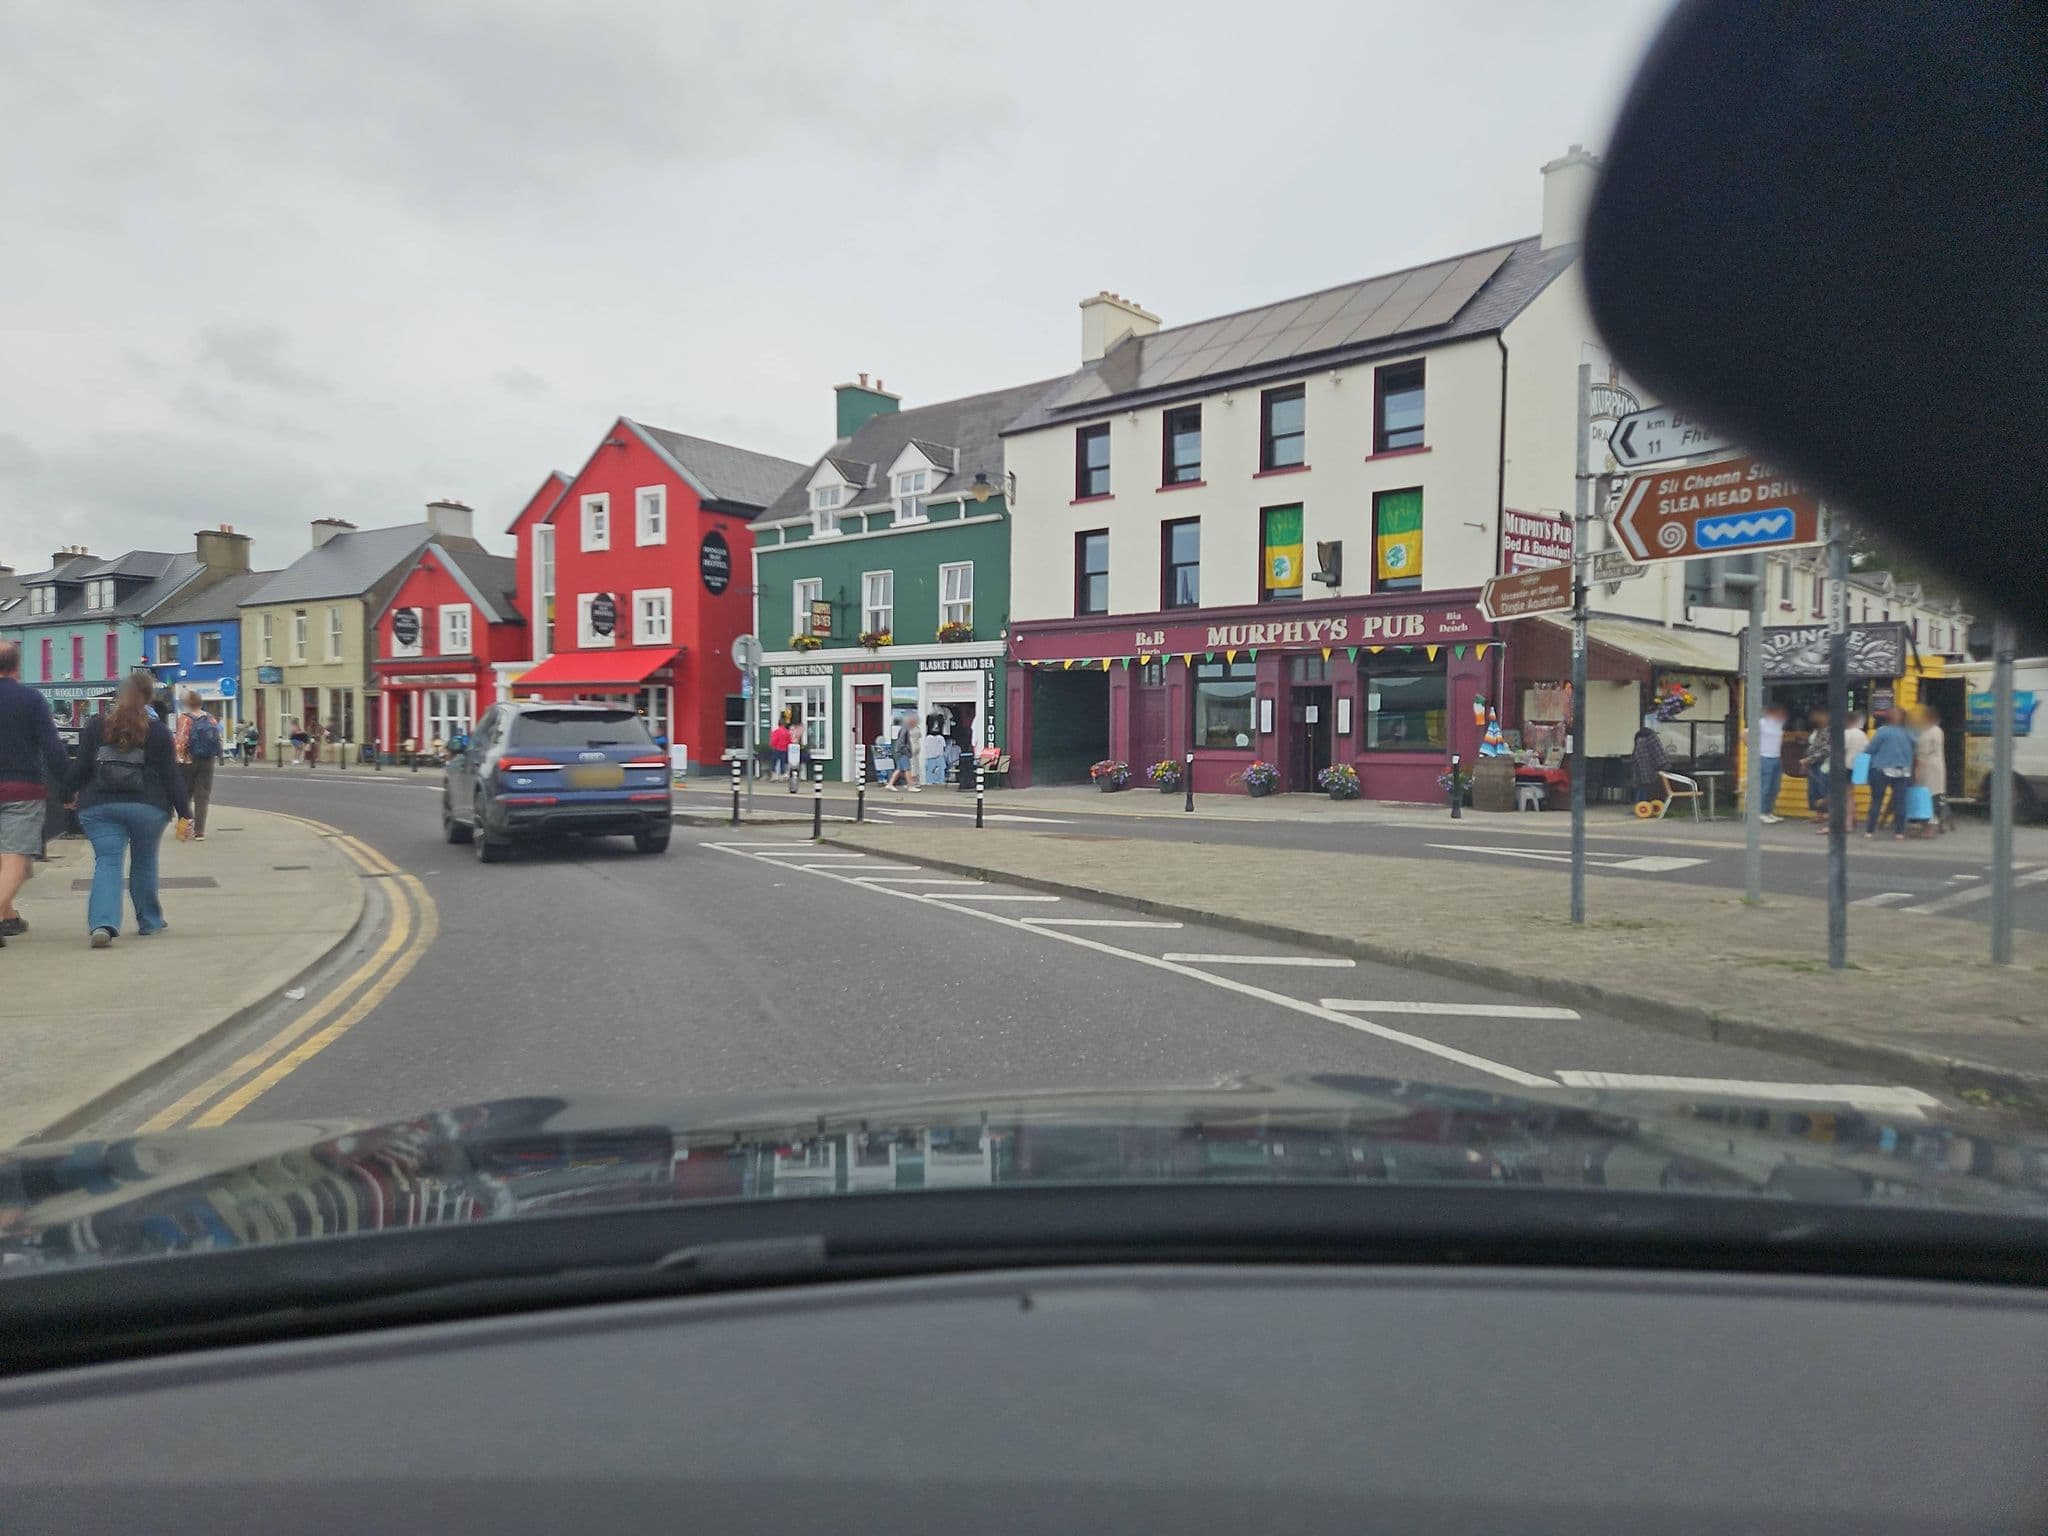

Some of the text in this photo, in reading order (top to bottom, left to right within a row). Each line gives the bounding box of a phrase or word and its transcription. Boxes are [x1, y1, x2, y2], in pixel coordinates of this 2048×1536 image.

[1647, 419, 1665, 430] km
[1649, 440, 1661, 454] 11
[1683, 471, 1741, 491] Cheann
[1659, 498, 1700, 515] SLEA
[1704, 486, 1752, 507] HEAD
[1552, 522, 1572, 543] PUB
[1505, 536, 1570, 559] Bed & Breakfast
[1527, 595, 1566, 609] Aquarium
[1446, 612, 1462, 621] Bia
[1207, 614, 1425, 647] MURPHY'S PUB
[1135, 630, 1165, 646] B&B
[770, 665, 785, 676] THE
[785, 665, 809, 676] WHITE
[810, 664, 834, 675] ROOM
[920, 658, 995, 671] BLASKET ISLAND SEA
[55, 686, 84, 697] WOOLLEN
